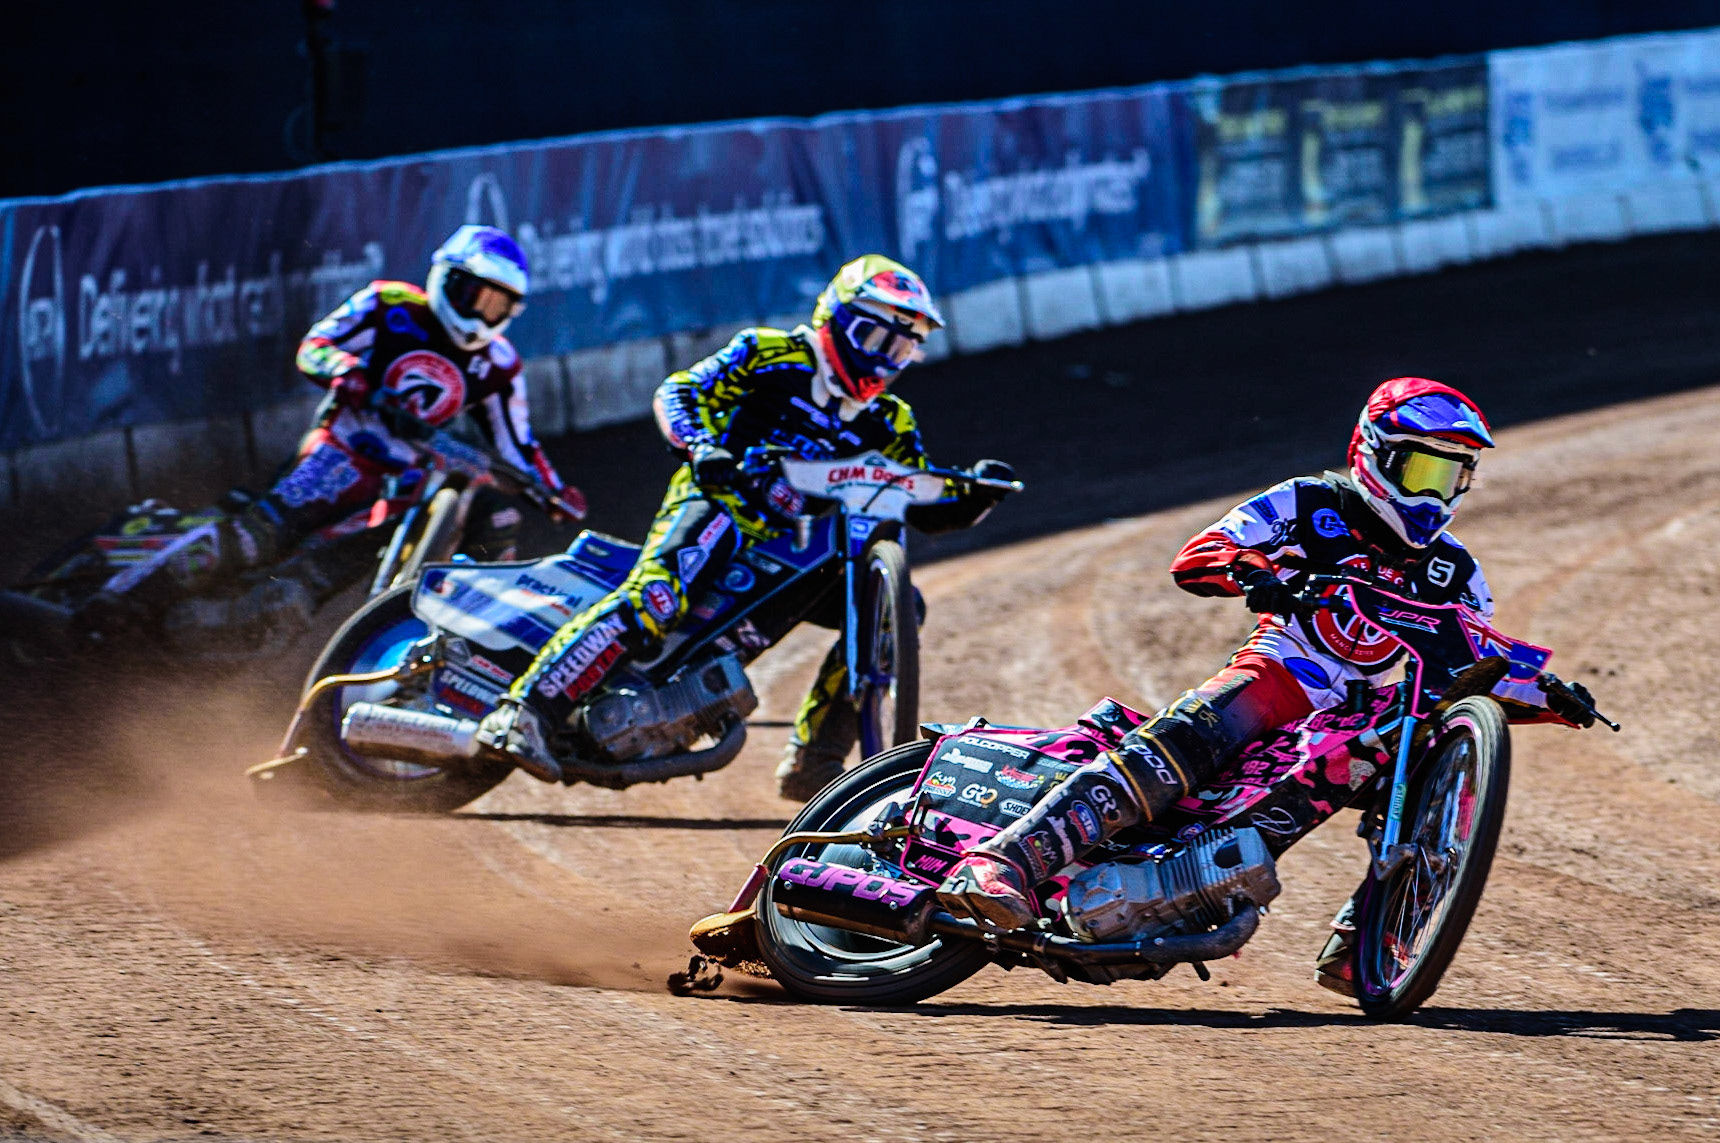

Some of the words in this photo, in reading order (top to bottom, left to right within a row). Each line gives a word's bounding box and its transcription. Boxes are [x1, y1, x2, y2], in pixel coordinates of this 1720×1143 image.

[1378, 610, 1441, 630] JPR
[537, 612, 627, 698] SPEEDWAY
[958, 736, 1030, 759] POLCOPPER
[1004, 802, 1031, 816] SHOE
